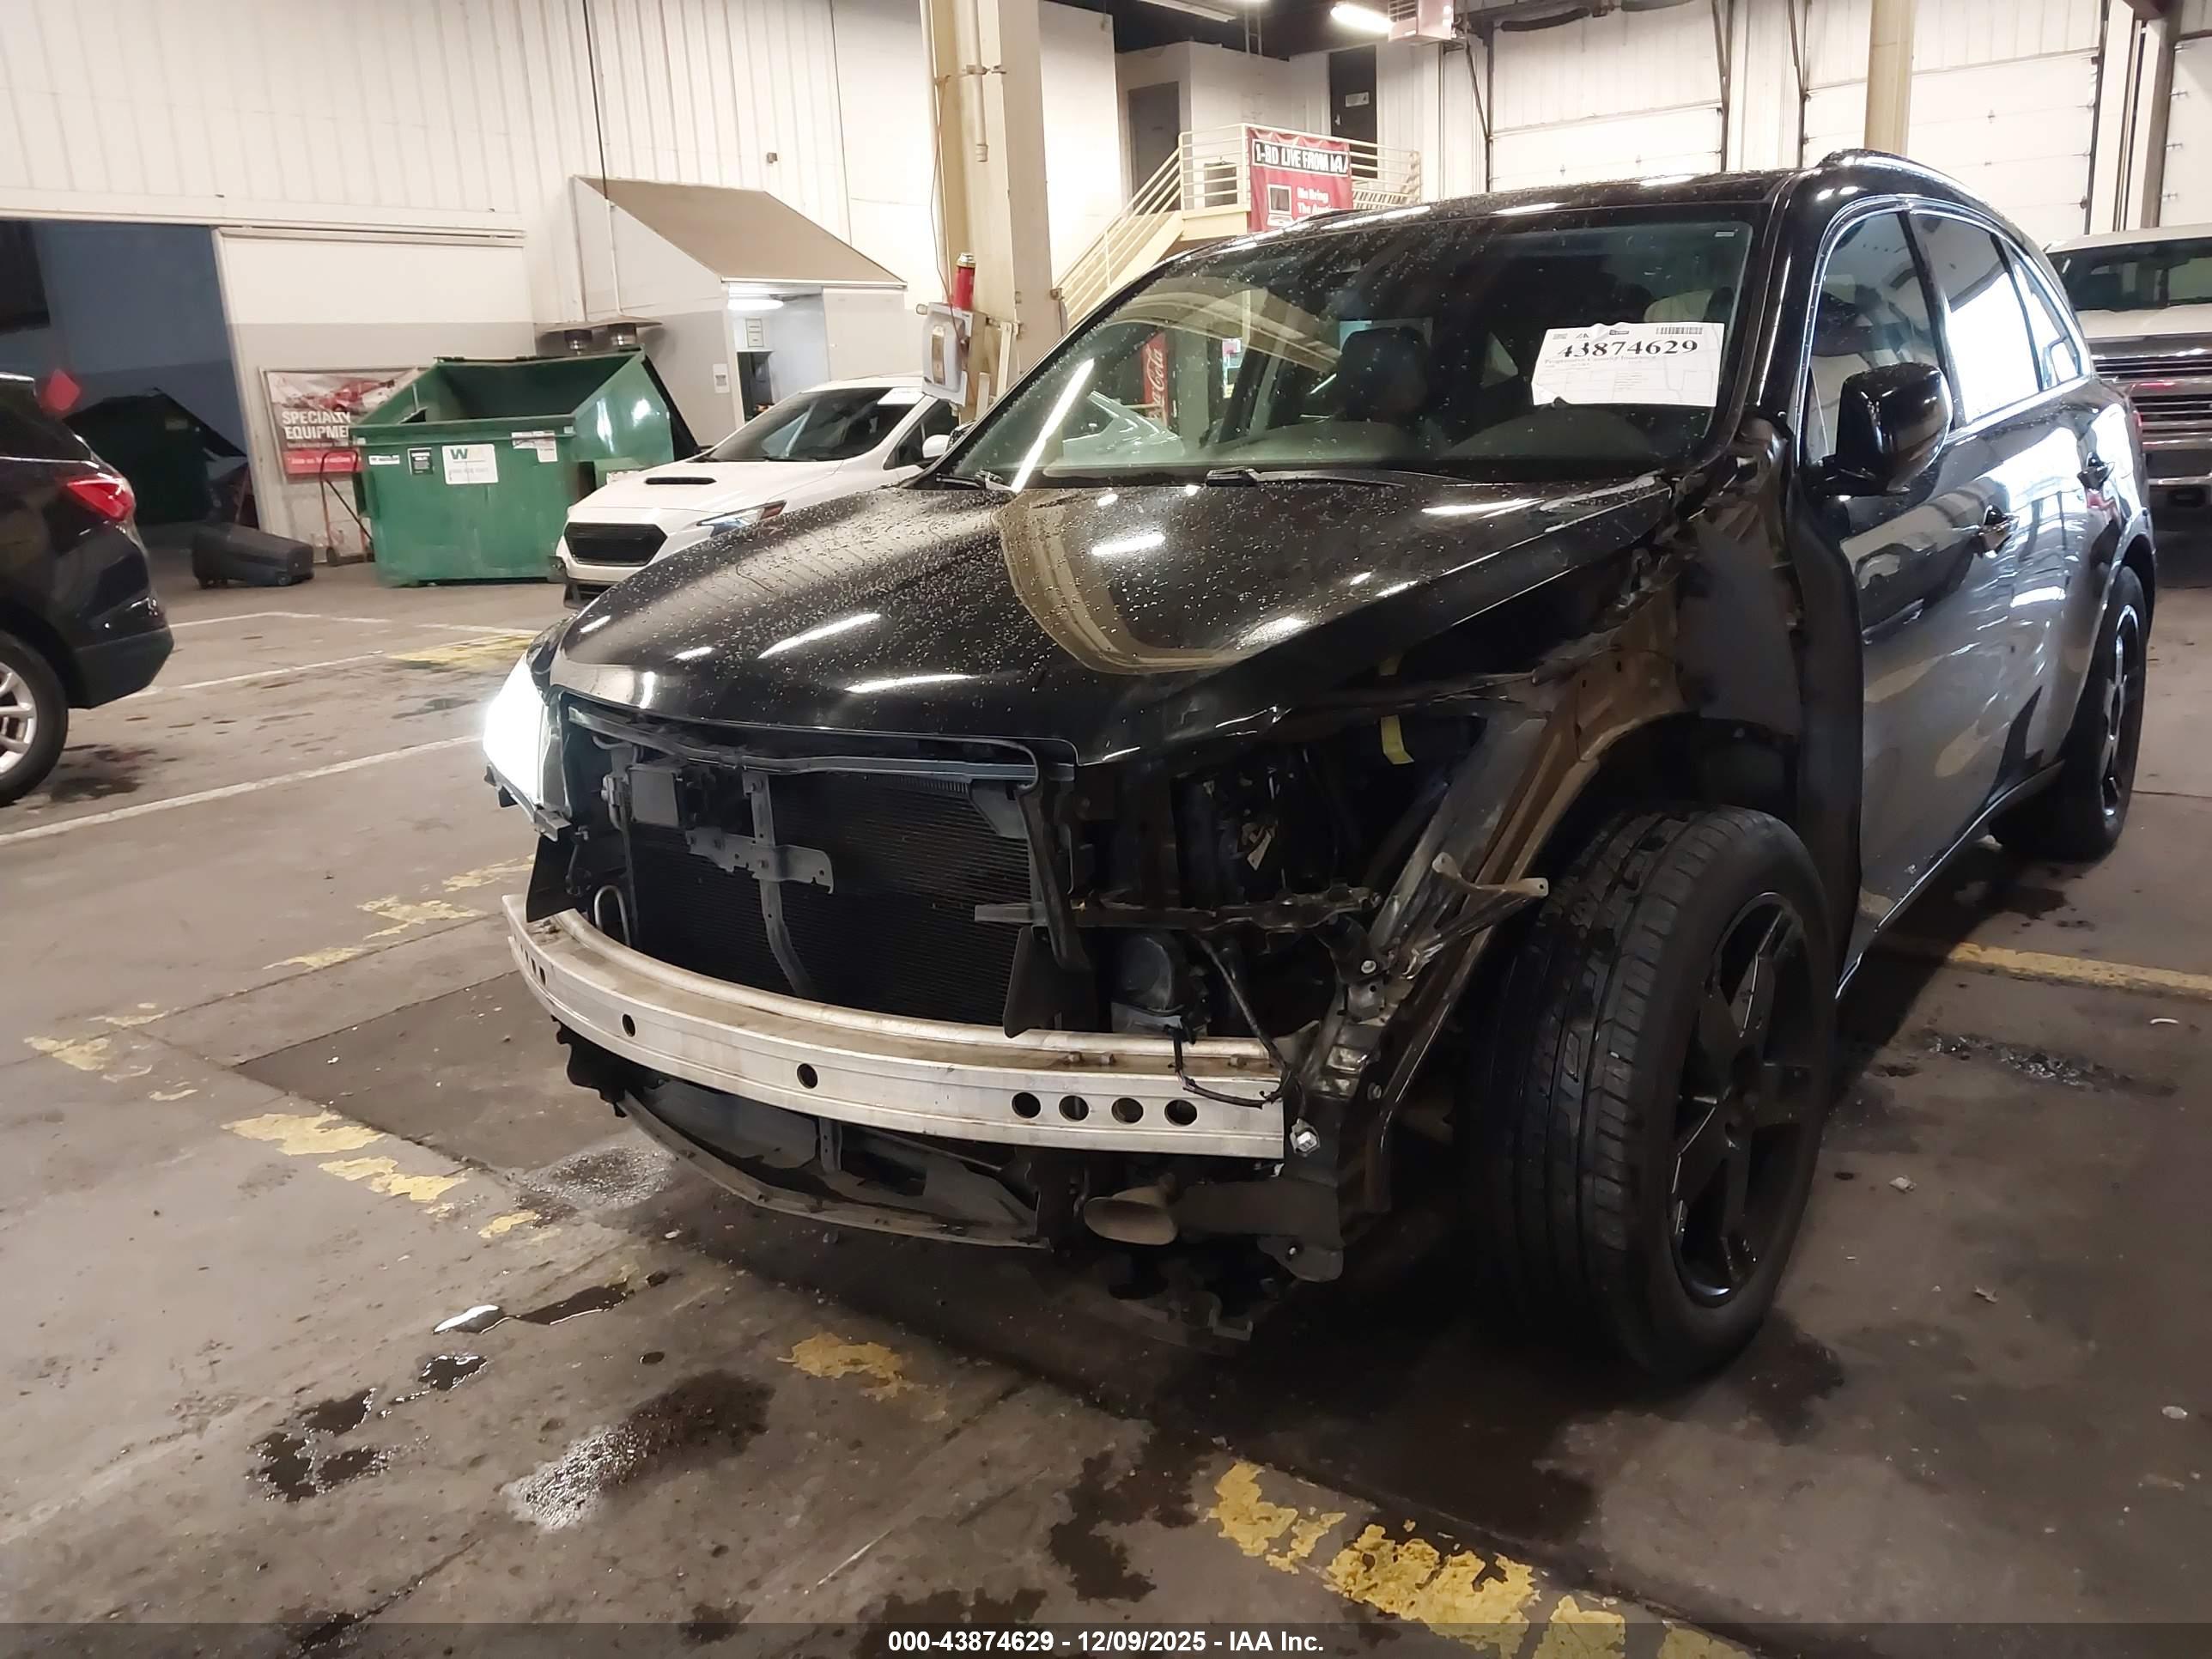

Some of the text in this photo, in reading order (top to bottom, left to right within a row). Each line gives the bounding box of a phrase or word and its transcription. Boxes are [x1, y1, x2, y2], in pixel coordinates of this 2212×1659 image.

[1302, 150, 1329, 172] FROM
[1557, 340, 1698, 358] 43874629
[282, 410, 351, 425] SPECIALTY
[284, 425, 349, 440] EQUIPME
